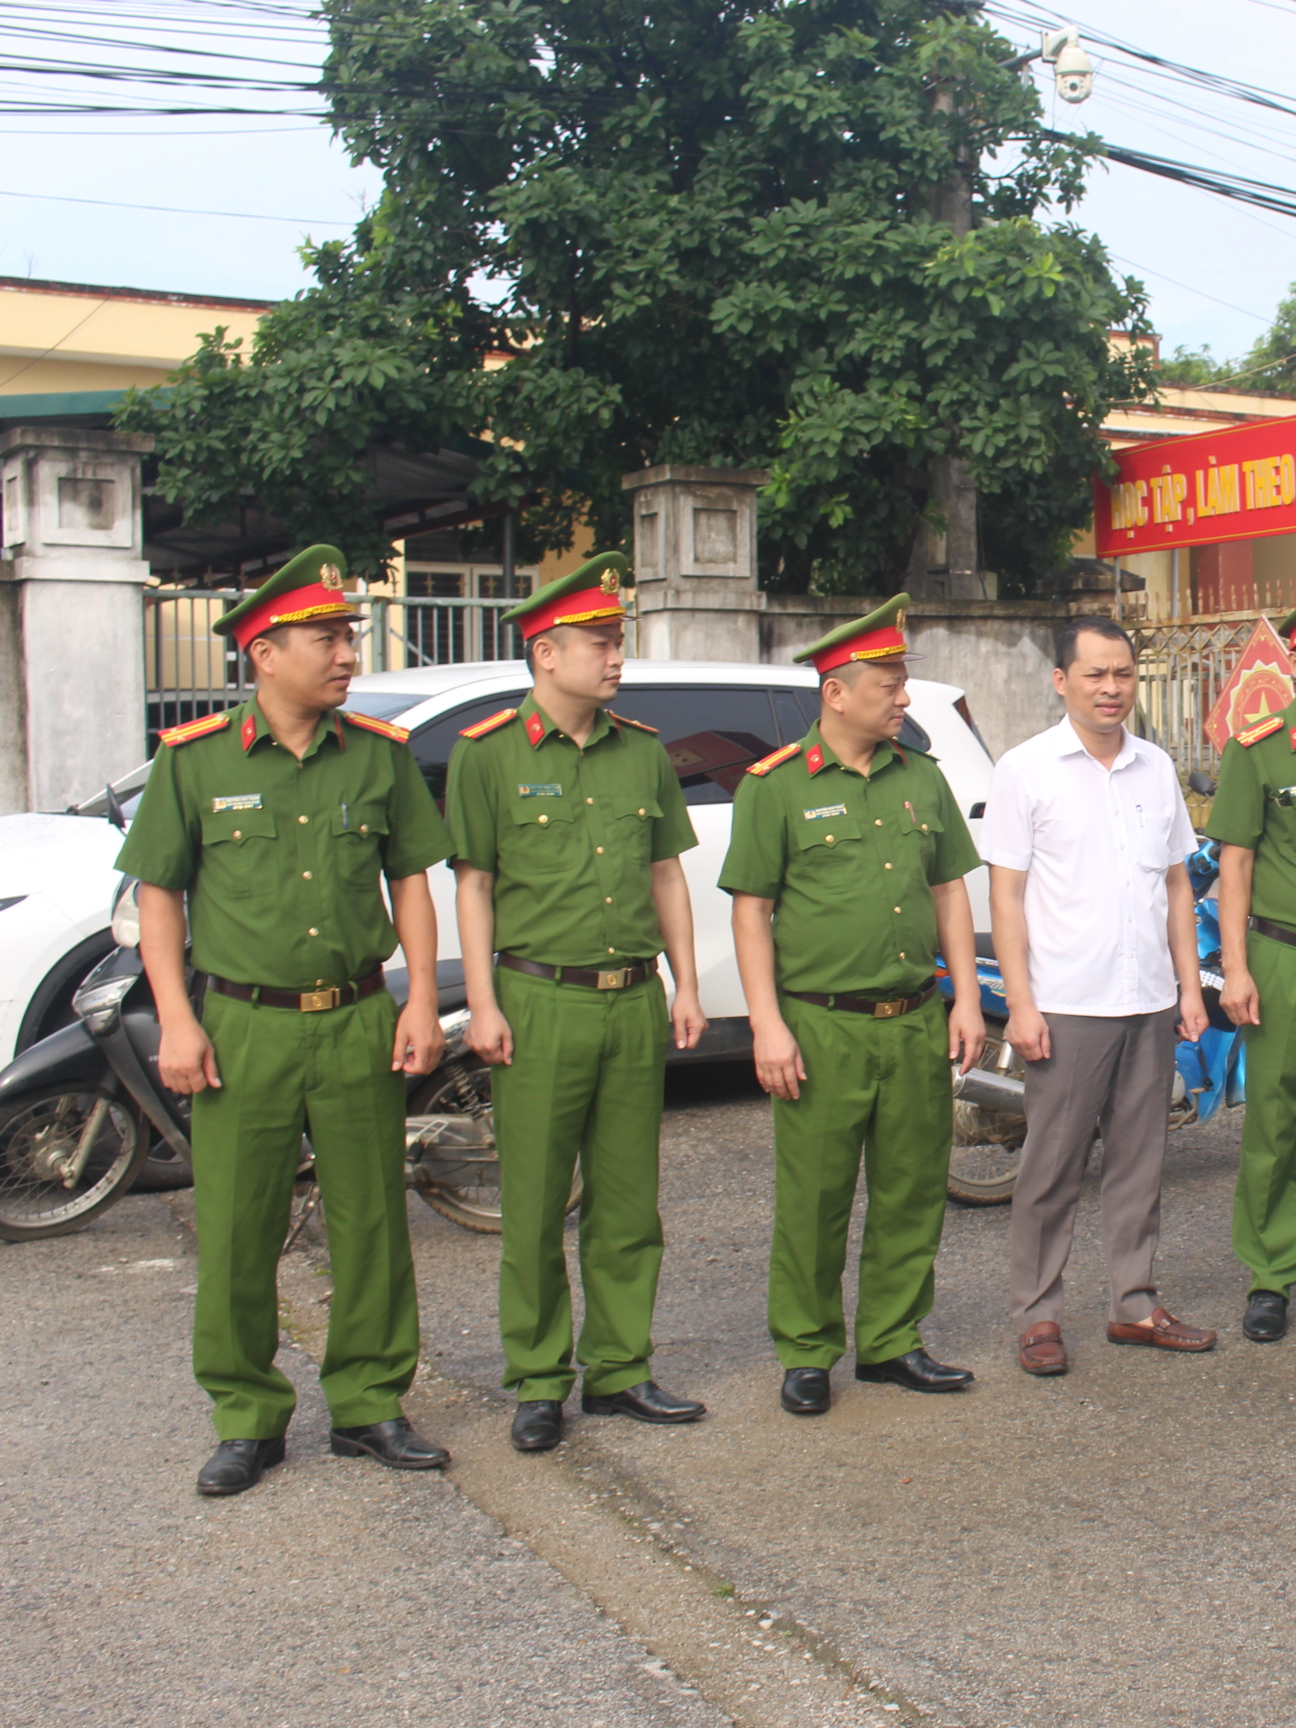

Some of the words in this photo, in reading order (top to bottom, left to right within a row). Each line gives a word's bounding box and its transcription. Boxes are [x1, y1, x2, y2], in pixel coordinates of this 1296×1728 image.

[1110, 479, 1149, 539] HỌC
[1195, 455, 1240, 518] LÀM
[1242, 452, 1296, 511] THEO
